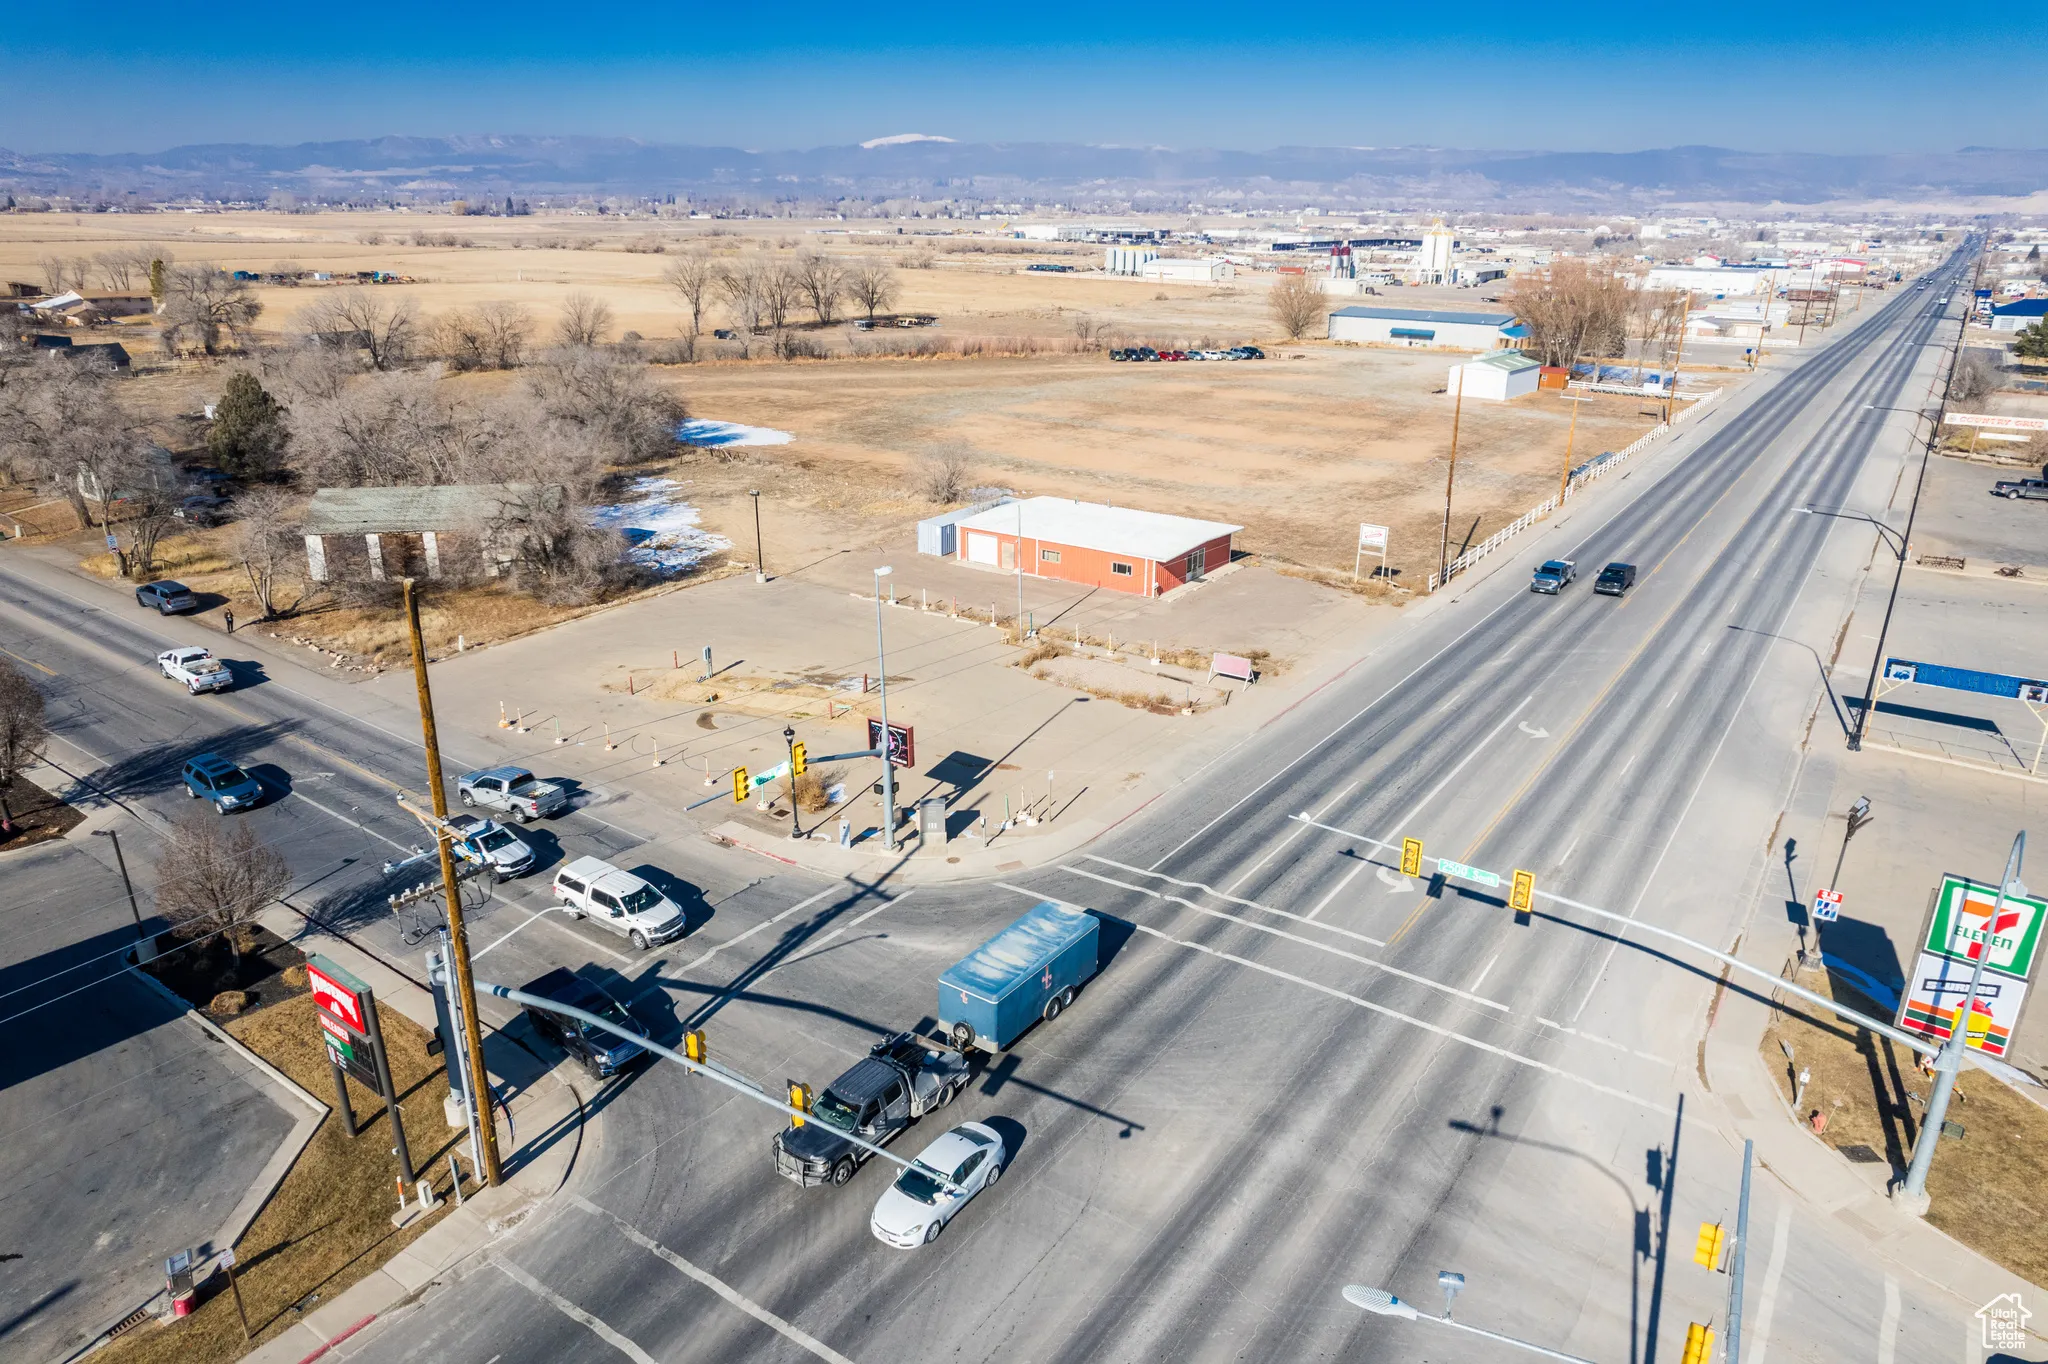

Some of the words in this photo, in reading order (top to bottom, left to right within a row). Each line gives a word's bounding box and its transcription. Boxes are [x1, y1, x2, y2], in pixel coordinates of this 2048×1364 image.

[1959, 416, 2012, 426] COUNTRY
[1442, 861, 1468, 877] 2500
[1472, 870, 1495, 885] South
[1925, 981, 1997, 995] SLUREE
[320, 1014, 349, 1042] UNLEADED
